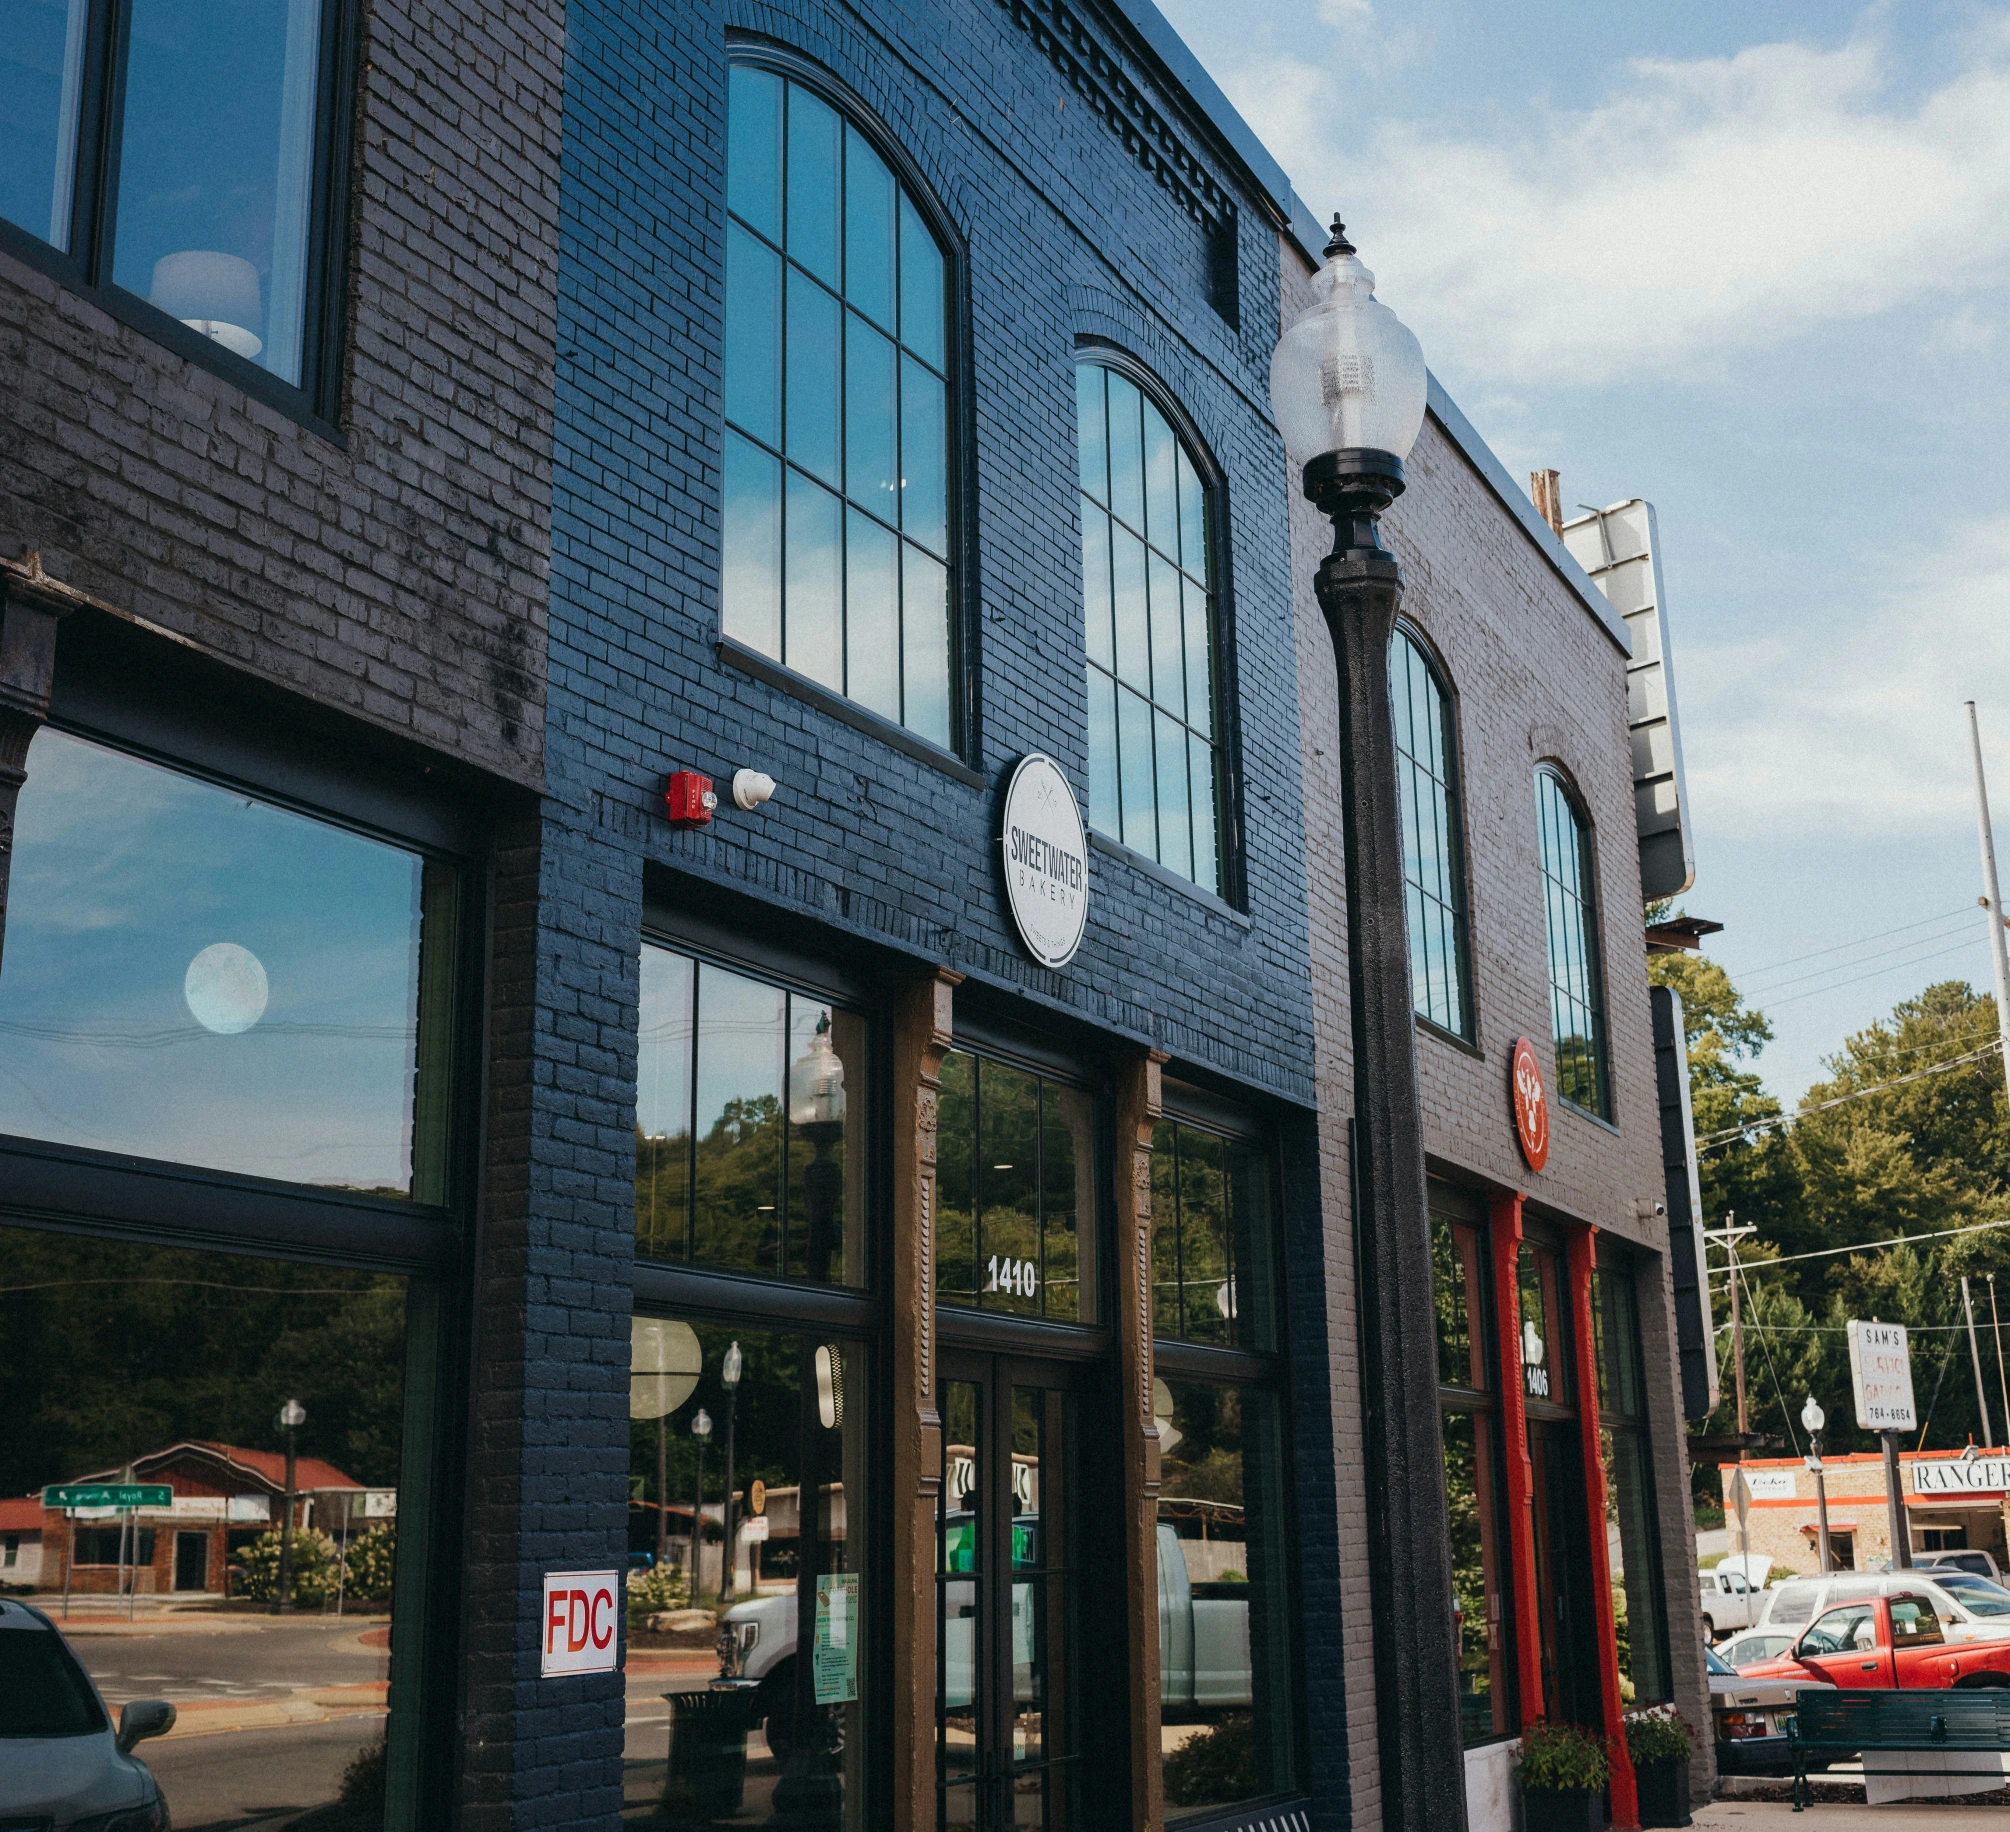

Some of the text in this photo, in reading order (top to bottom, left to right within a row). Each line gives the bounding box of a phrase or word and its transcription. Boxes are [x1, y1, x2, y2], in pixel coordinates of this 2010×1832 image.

[1011, 825, 1082, 892] SWEETWATER
[1019, 868, 1076, 910] BAKERY
[987, 1254, 1035, 1297] 1410
[1866, 1329, 1899, 1346] SAM'S
[1527, 1366, 1548, 1396] 1406
[547, 1588, 613, 1654] FDC
